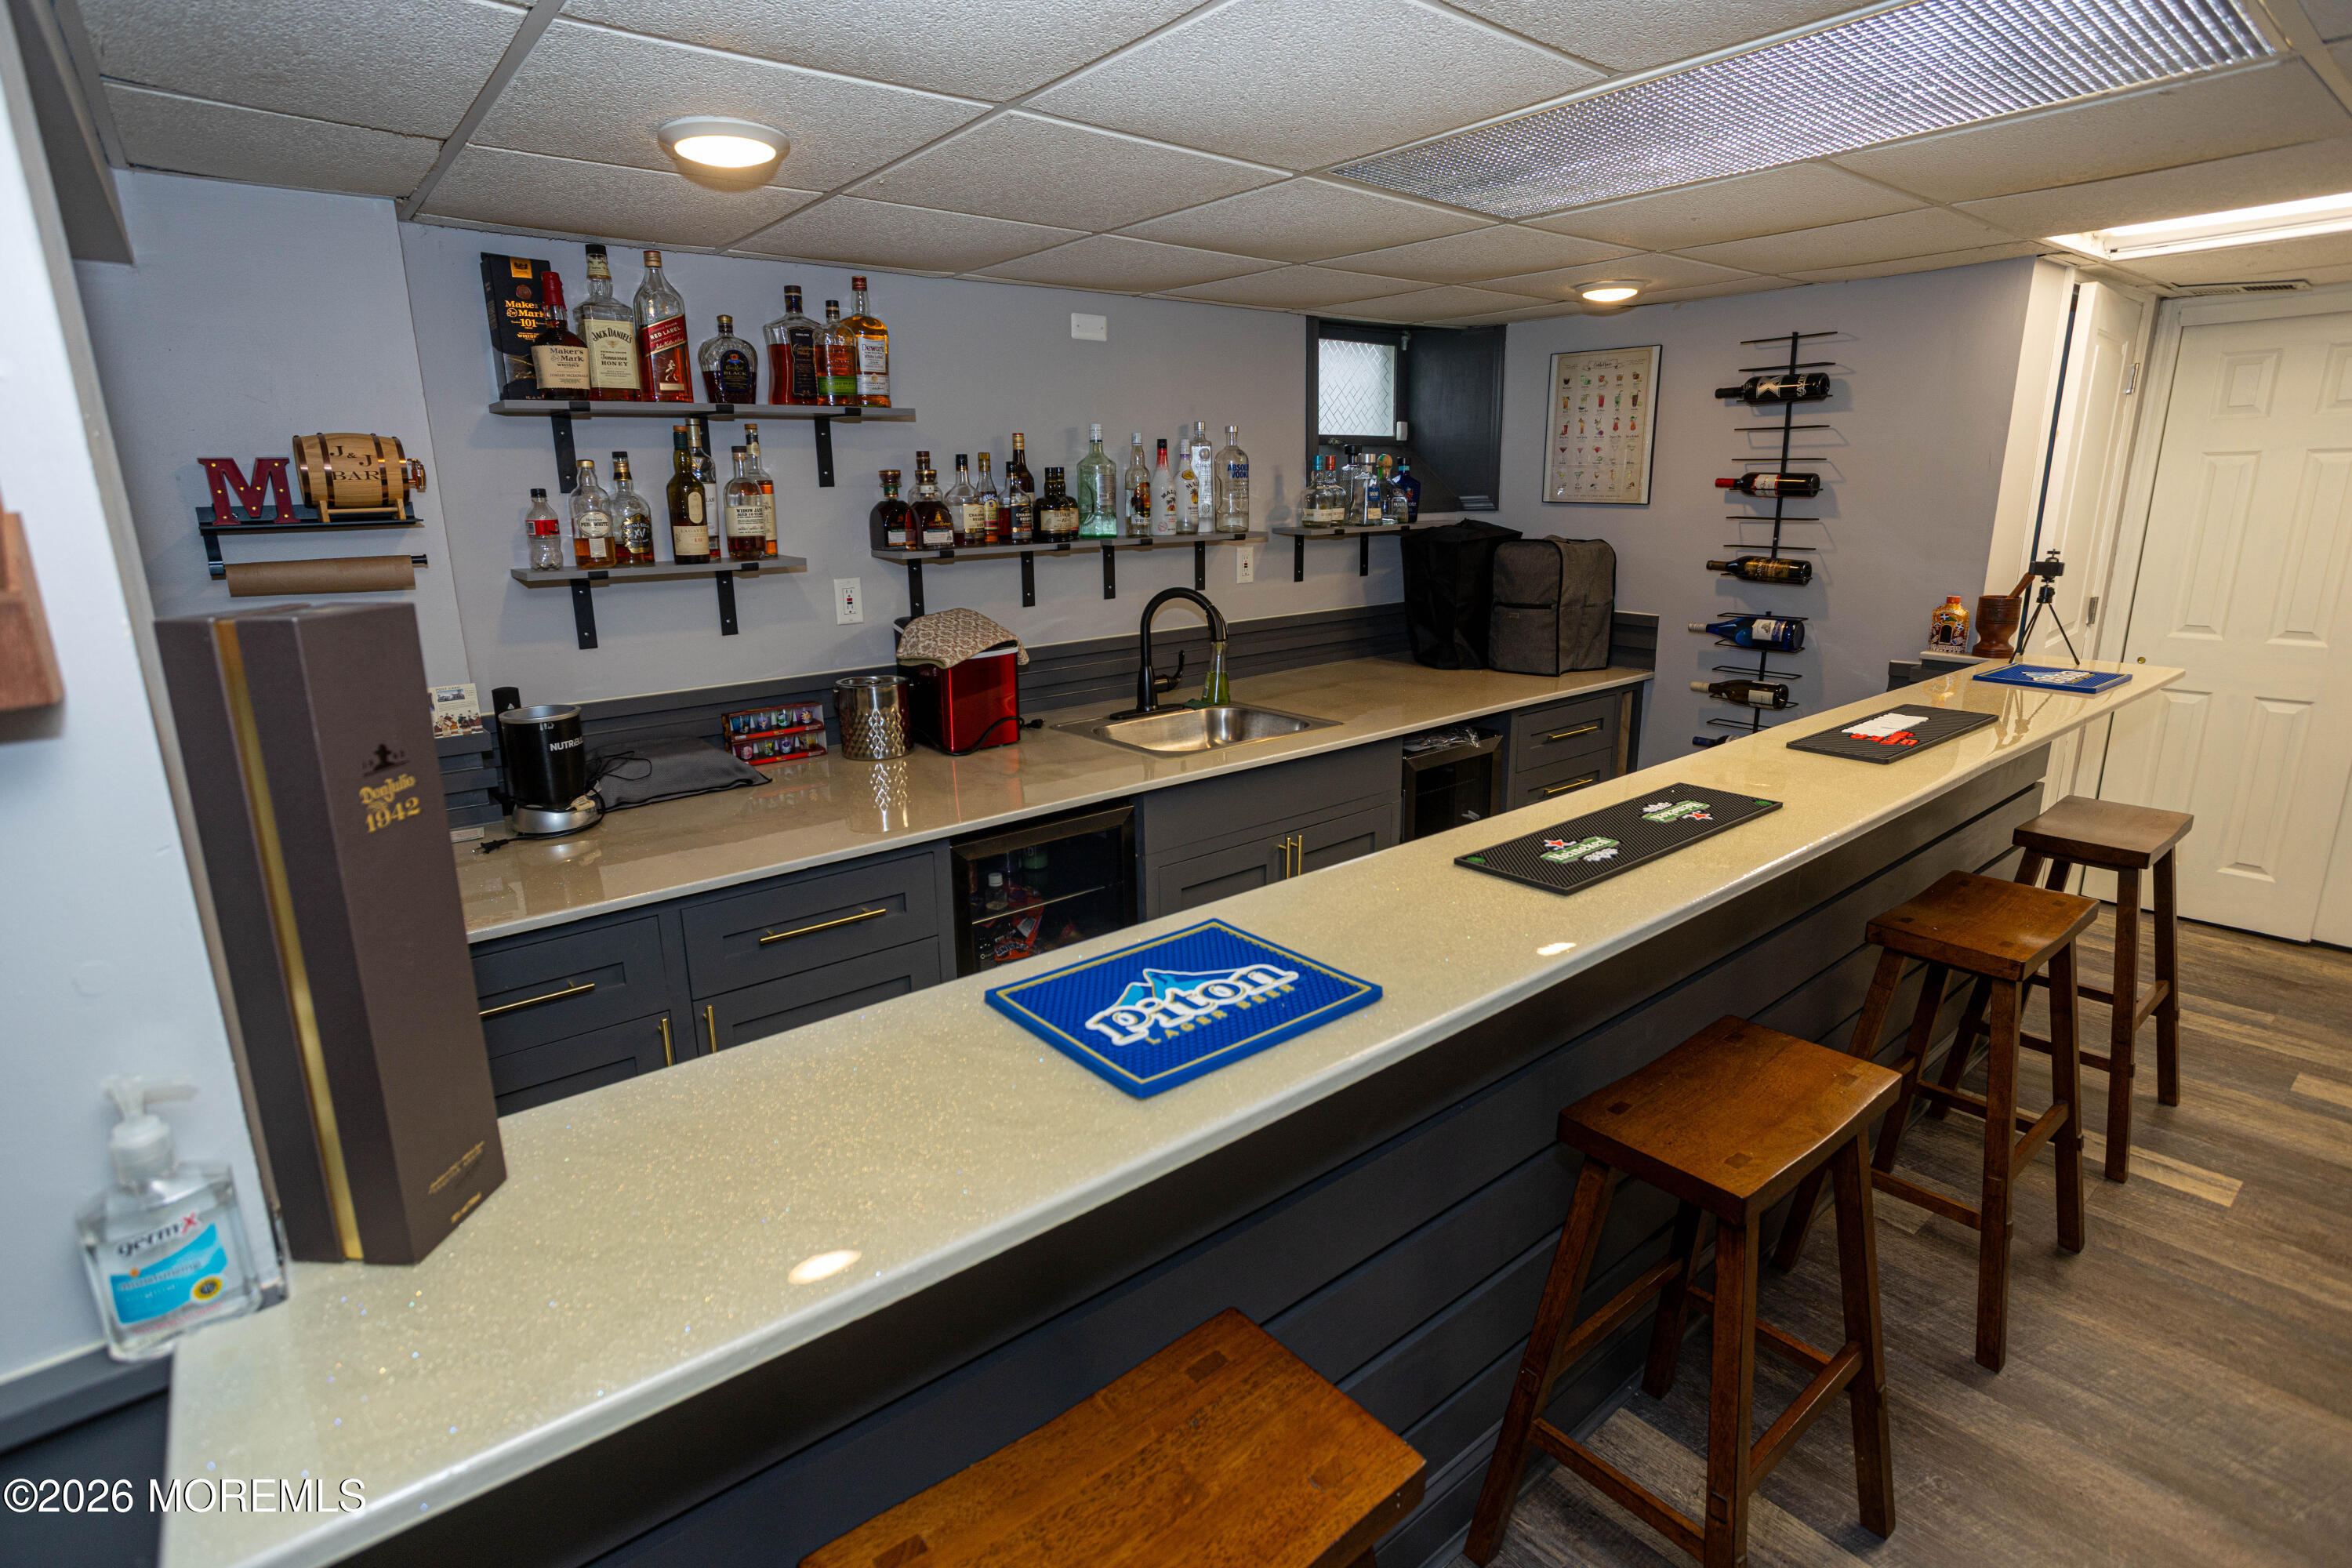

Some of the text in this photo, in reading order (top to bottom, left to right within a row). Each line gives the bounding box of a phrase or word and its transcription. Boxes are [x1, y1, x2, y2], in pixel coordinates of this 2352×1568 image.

[520, 318, 538, 328] 101
[591, 327, 632, 344] JACK DANIEL'S
[649, 326, 681, 340] RED LABEL
[862, 344, 885, 353] Dewar's
[330, 446, 343, 457] J
[359, 455, 372, 467] J
[332, 470, 380, 481] BAR
[198, 458, 301, 525] M
[633, 528, 646, 539] XV
[366, 797, 421, 833] 1942
[1548, 837, 1611, 861] Heineken
[1085, 964, 1299, 1046] Piton
[1145, 984, 1295, 1044] LAGER BEER
